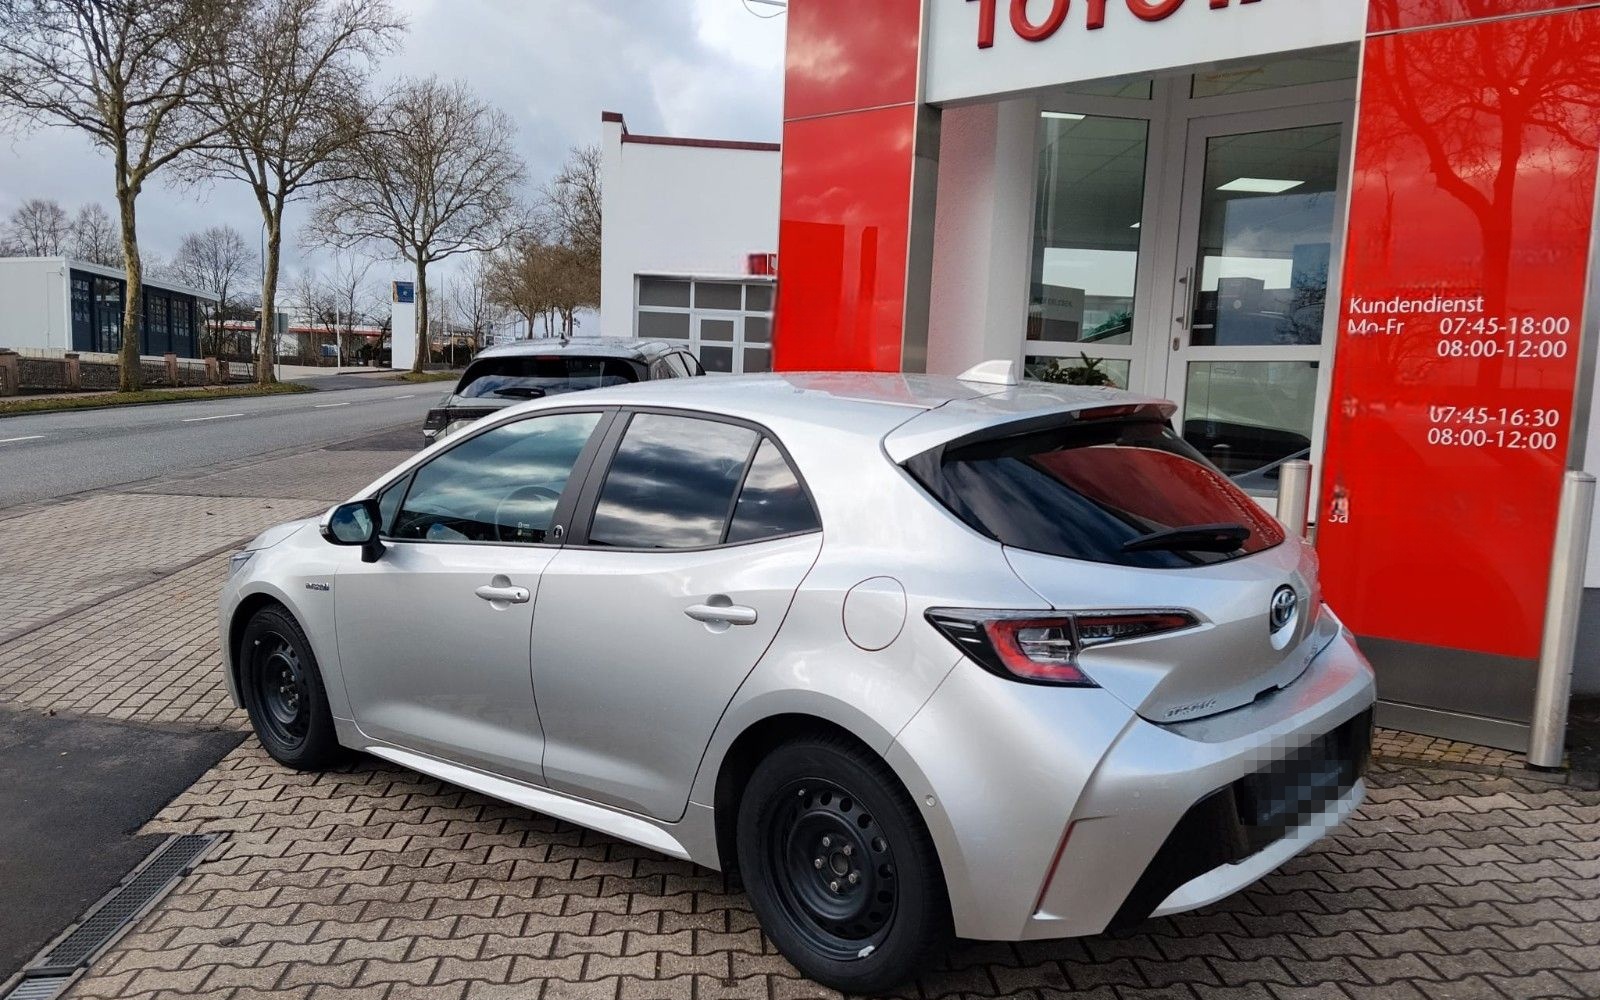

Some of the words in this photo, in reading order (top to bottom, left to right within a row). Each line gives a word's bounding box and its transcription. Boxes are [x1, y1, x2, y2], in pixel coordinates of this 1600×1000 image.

[965, 0, 1263, 49] TOY
[1349, 295, 1484, 314] Kundendienst
[1347, 318, 1404, 335] Mo-Fr
[1439, 316, 1570, 335] 07:45-18:00
[1437, 339, 1568, 358] 08:00-12:00
[1429, 405, 1560, 427] 07:45-16:30
[1427, 427, 1557, 450] 08:00-12:00
